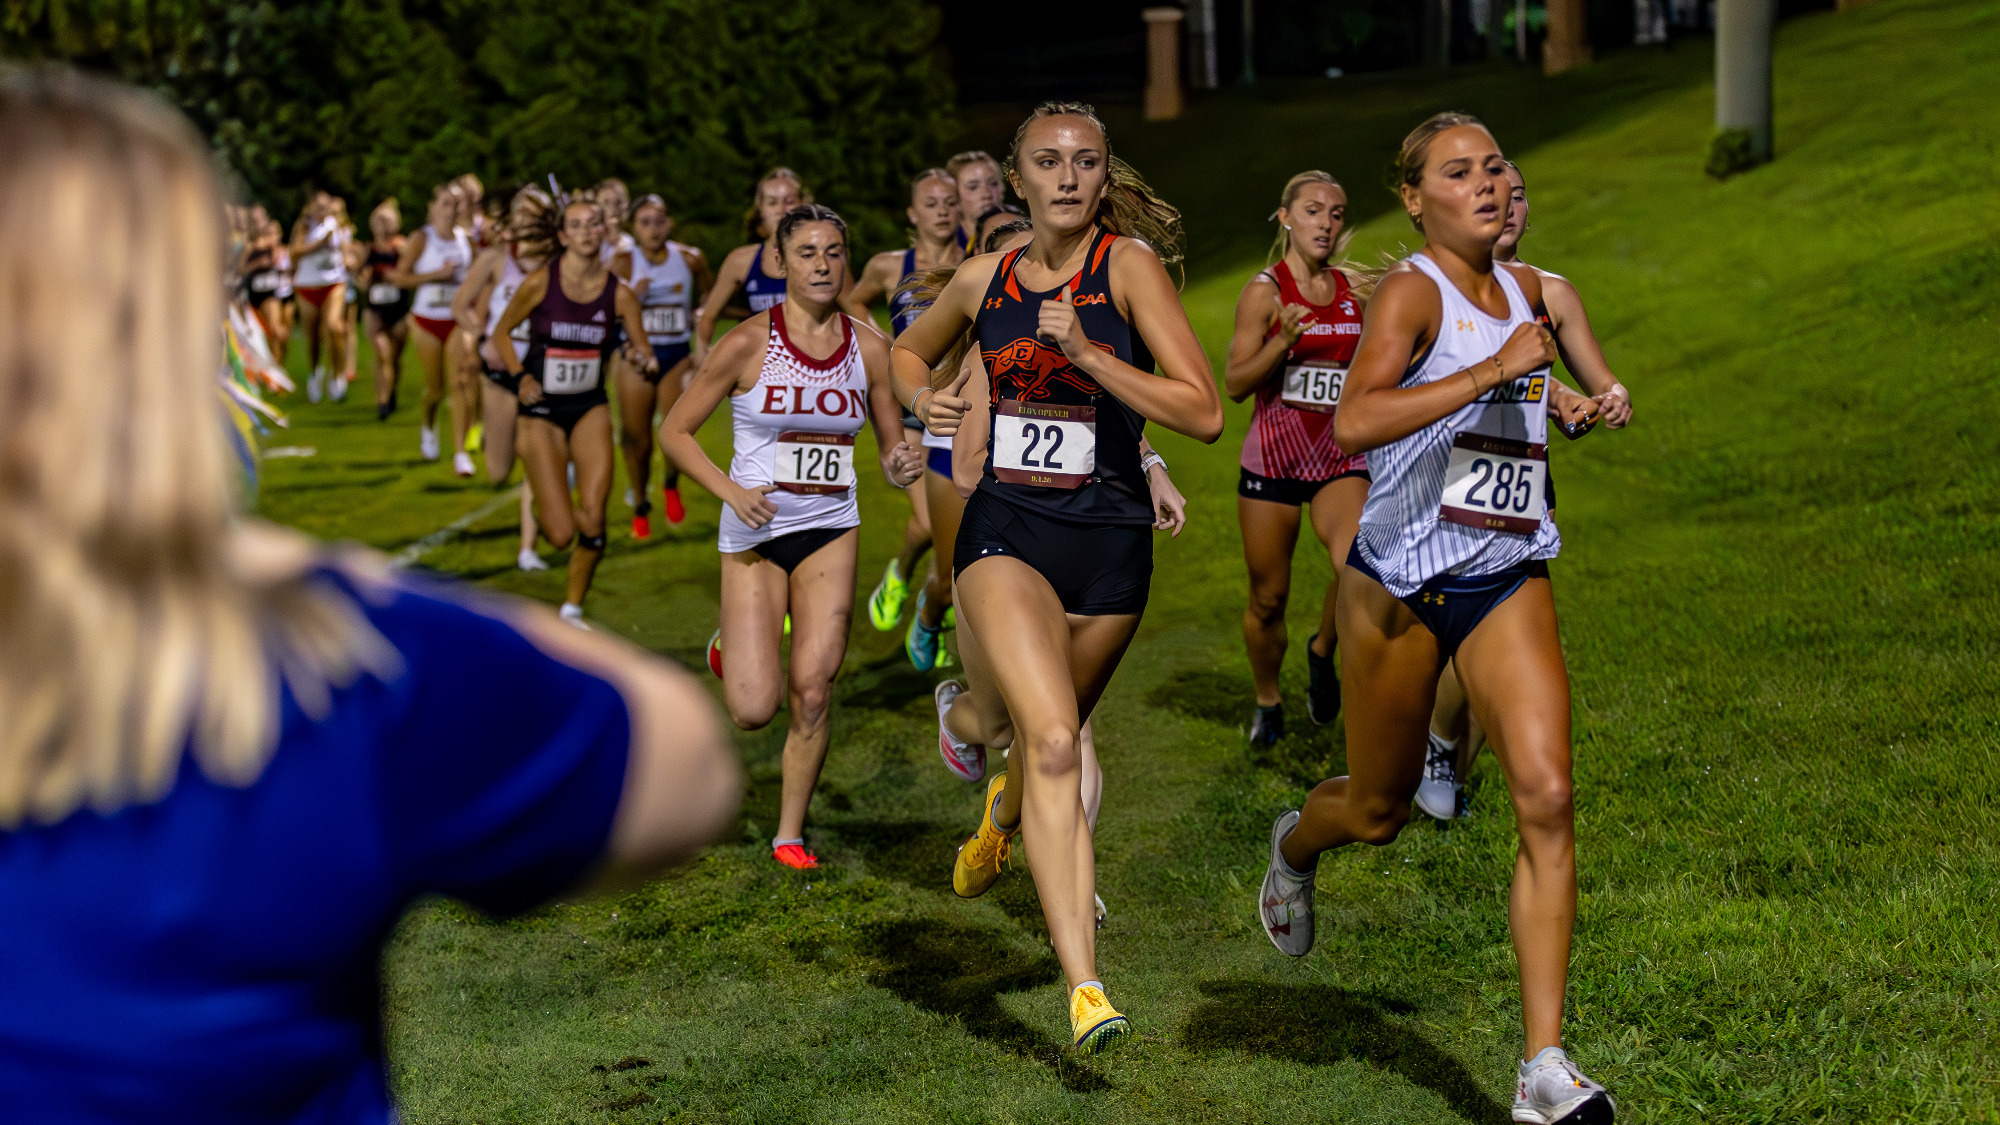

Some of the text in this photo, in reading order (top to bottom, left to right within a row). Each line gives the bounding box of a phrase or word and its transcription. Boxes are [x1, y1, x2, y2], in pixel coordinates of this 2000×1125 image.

[1073, 293, 1107, 307] CAA
[556, 363, 588, 384] 317
[1300, 370, 1342, 402] 156
[760, 386, 867, 419] ELON
[1021, 422, 1064, 470] 22
[792, 447, 841, 482] 126
[1464, 457, 1533, 514] 285
